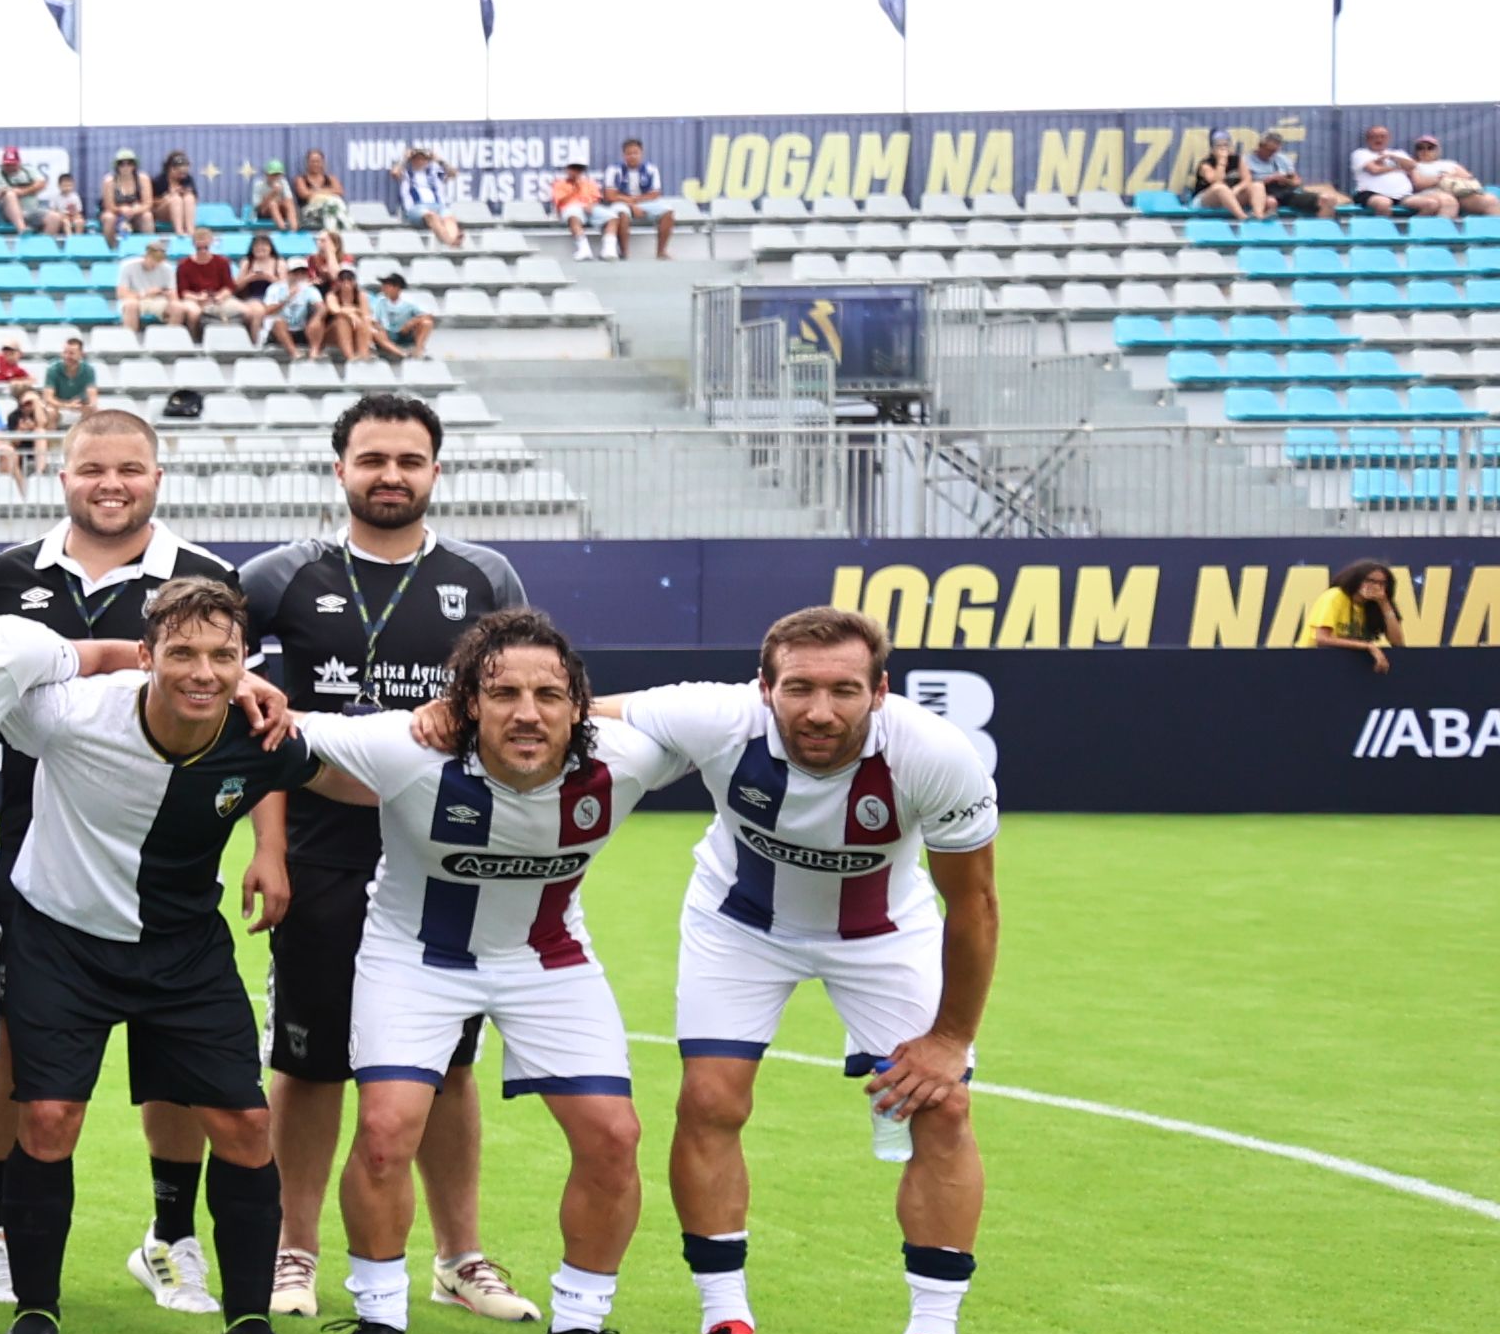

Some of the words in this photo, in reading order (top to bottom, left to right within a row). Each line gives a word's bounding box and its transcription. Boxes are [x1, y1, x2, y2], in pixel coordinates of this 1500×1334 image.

[550, 136, 591, 167] EM
[682, 133, 911, 204] JOGAM
[926, 130, 1014, 197] NA
[479, 170, 514, 203] AS
[373, 660, 405, 680] aixa
[385, 680, 426, 697] Torres
[454, 855, 580, 878] Agriloja
[750, 833, 873, 873] Agriloja
